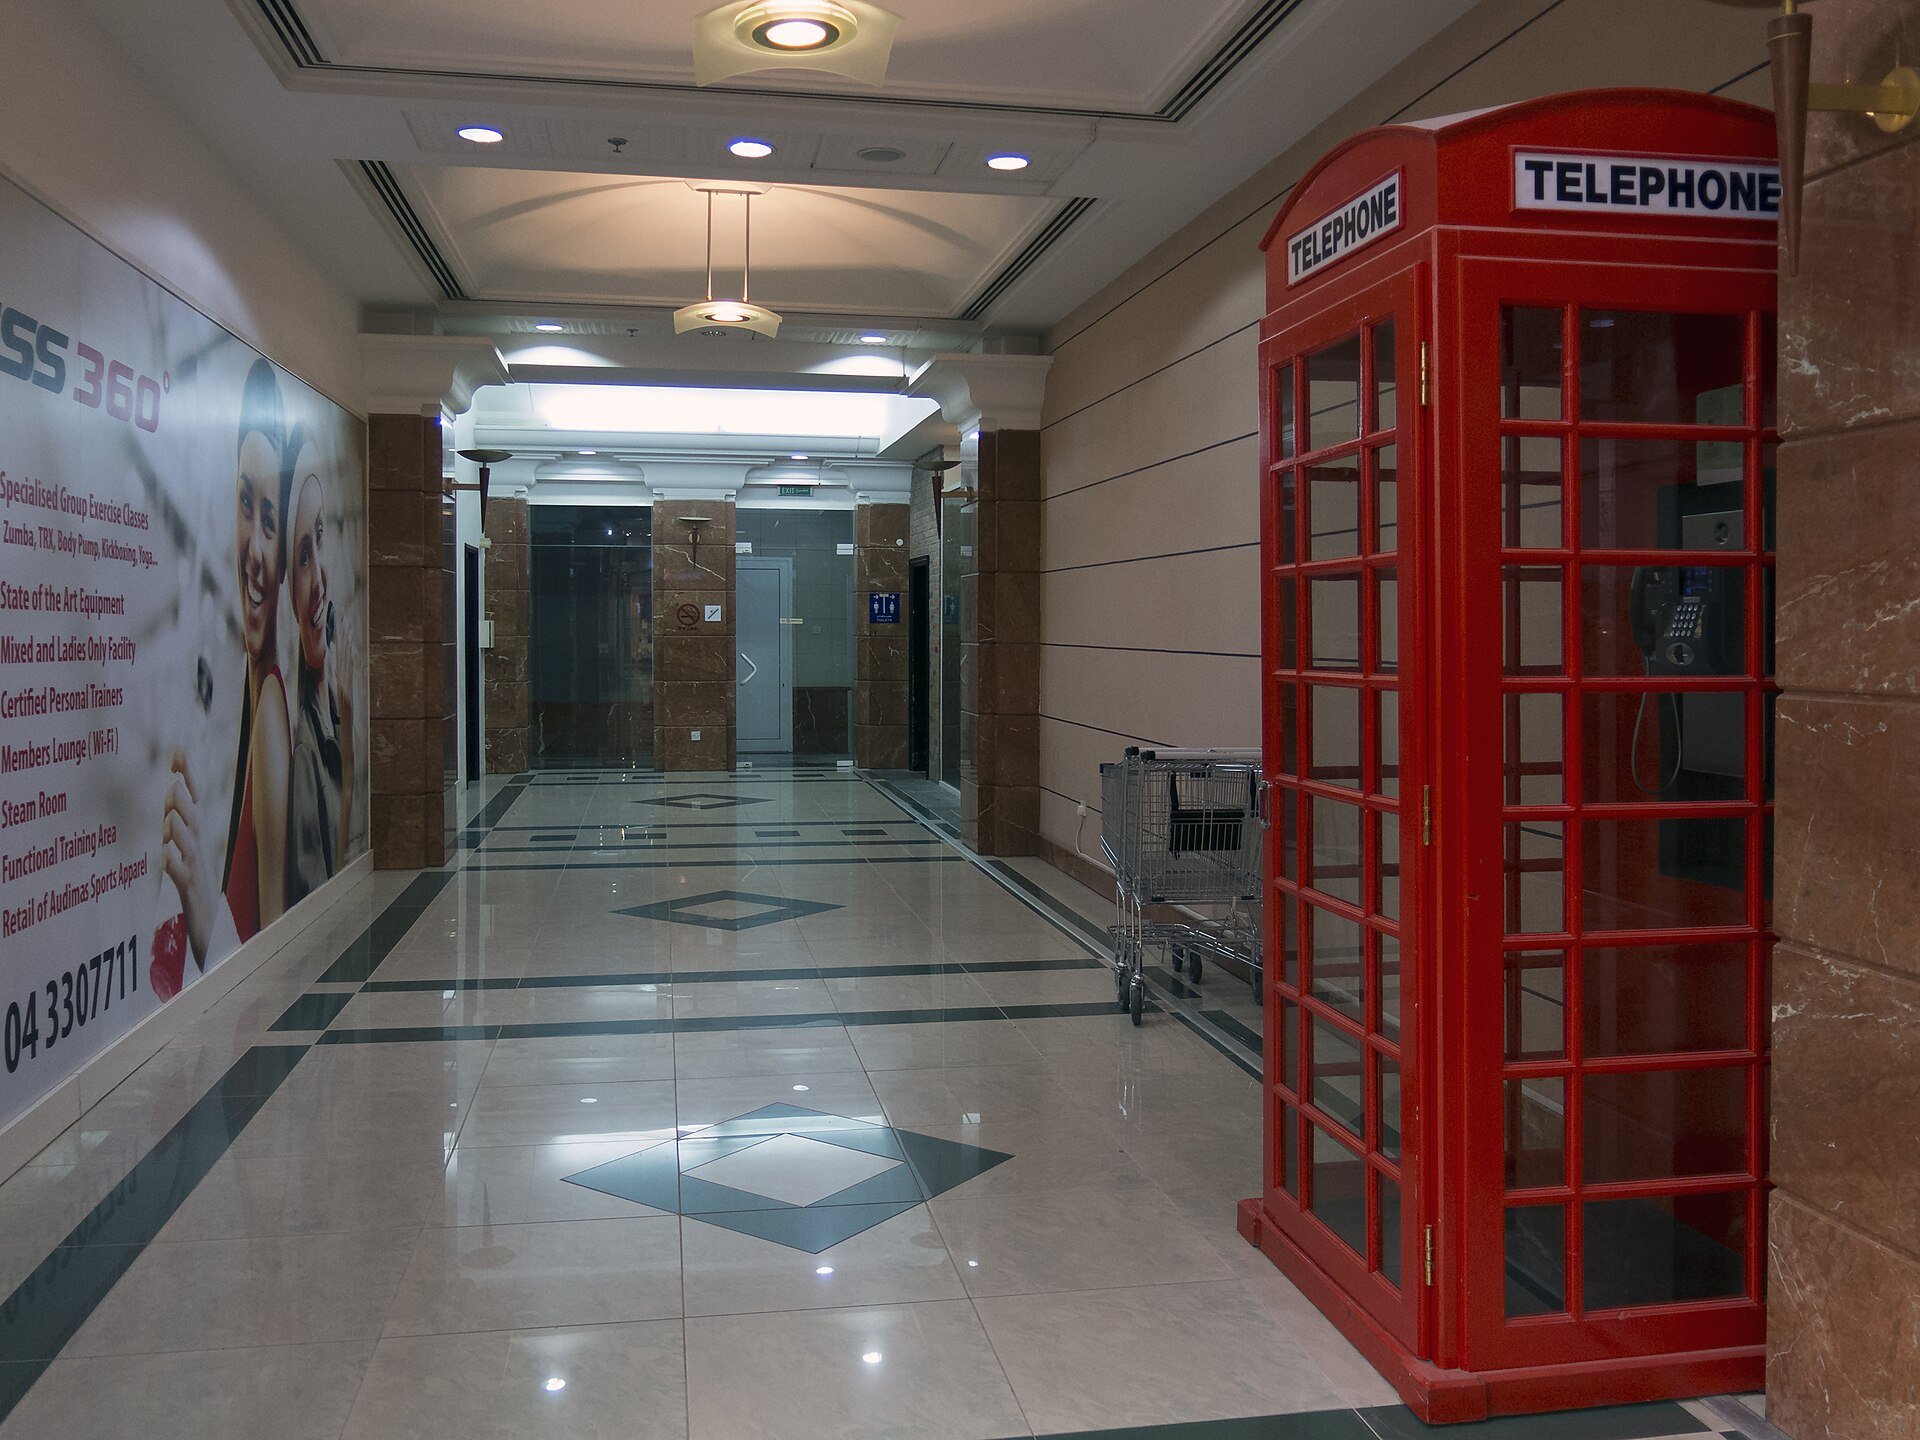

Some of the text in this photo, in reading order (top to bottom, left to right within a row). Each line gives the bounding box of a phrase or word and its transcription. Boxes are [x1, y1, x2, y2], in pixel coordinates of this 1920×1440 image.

[1525, 160, 1782, 212] TELEPHONE
[1291, 182, 1397, 276] TELEPHONE
[0, 471, 149, 531] Specialised Group Exercise Classes
[781, 486, 795, 494] EXIT
[3, 520, 37, 551] Zumba,
[38, 526, 56, 553] TRX,
[58, 530, 77, 558] Body
[78, 534, 101, 562] Pump,
[102, 538, 138, 567] Kickboxing,
[0, 581, 125, 620] State of the Art Equipment
[0, 635, 136, 667] Mixed and Ladies Only Facility
[1, 683, 123, 719] Certified Personal Trainers
[1, 740, 51, 774] Members
[53, 737, 86, 766] Lounge
[1, 791, 67, 829] Steam Room
[2, 824, 117, 883] Functional Training Area
[2, 852, 148, 938] Retail of Audimas Sports Apparel
[4, 934, 137, 1074] 04 3307711
